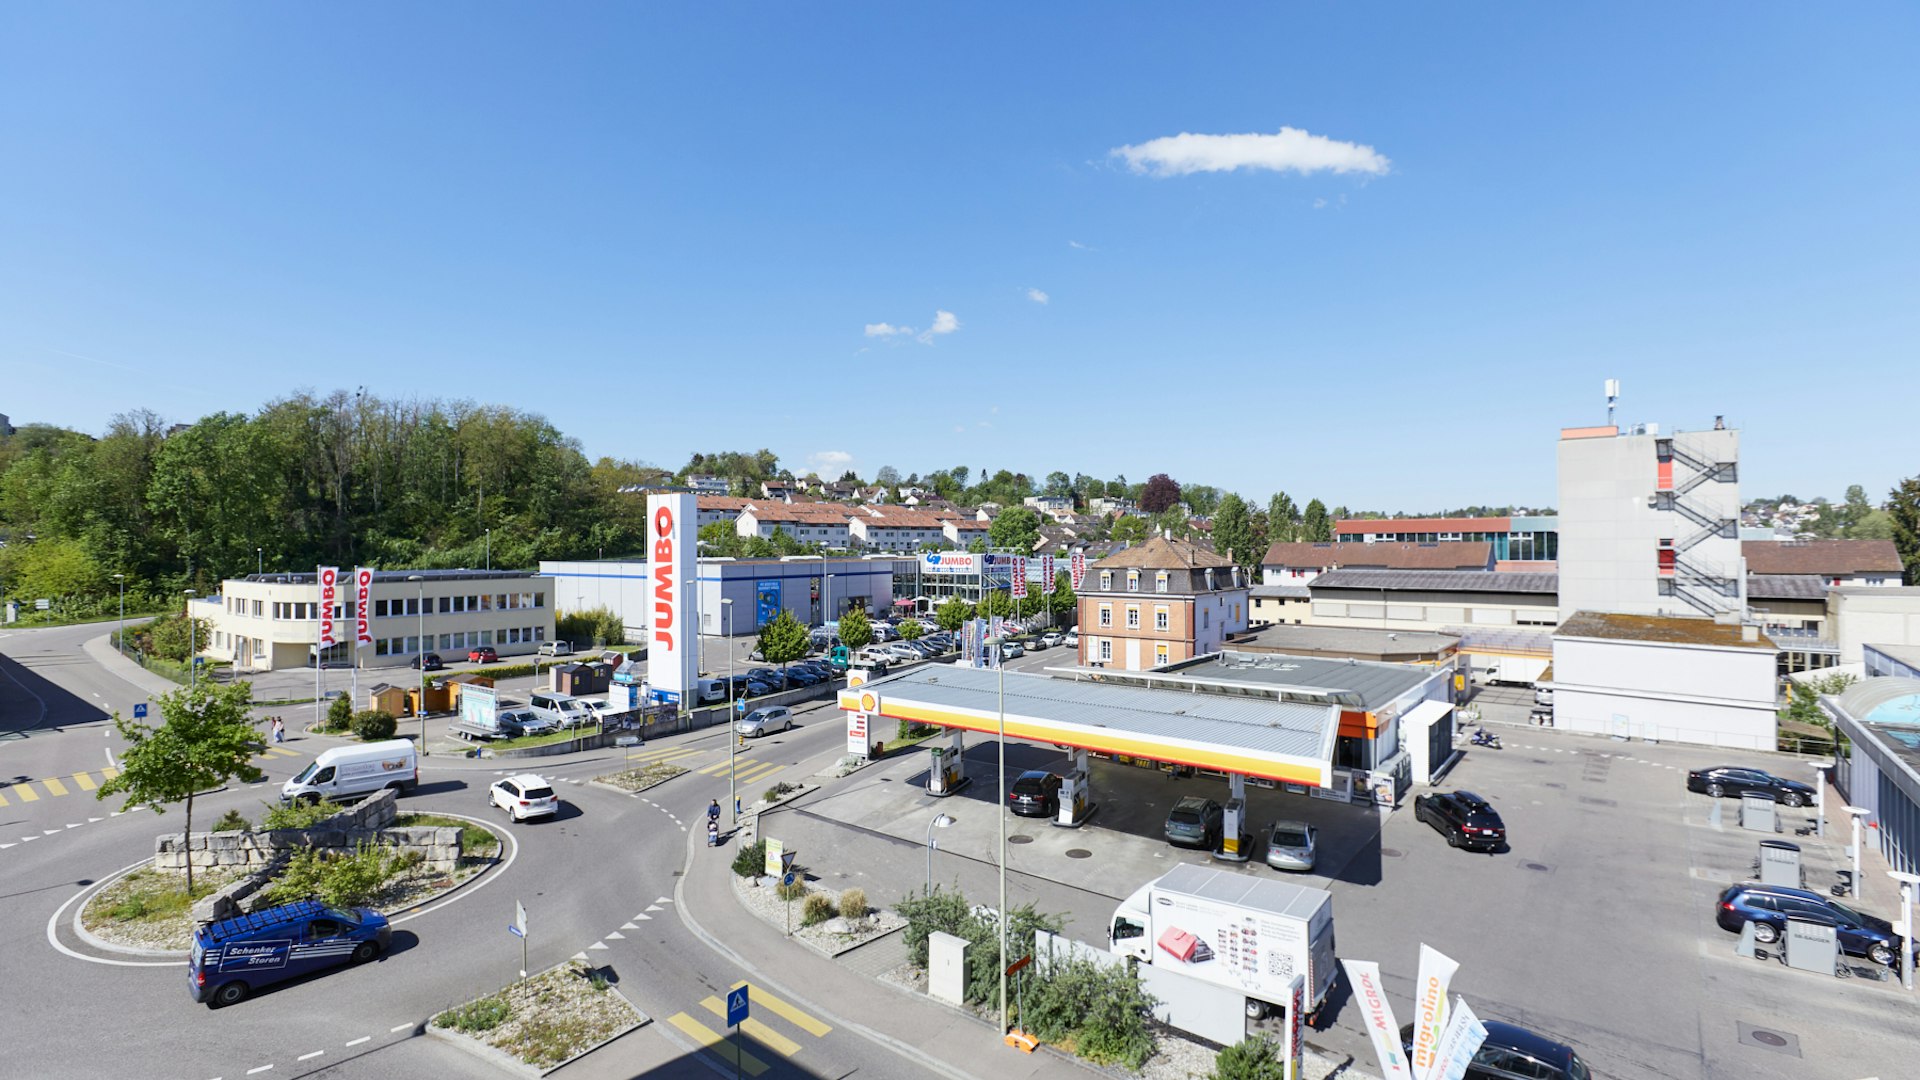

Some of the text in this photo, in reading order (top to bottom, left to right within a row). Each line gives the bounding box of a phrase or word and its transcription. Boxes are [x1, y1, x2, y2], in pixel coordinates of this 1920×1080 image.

[655, 506, 673, 651] JUMBO
[940, 557, 972, 566] JUMBO
[993, 556, 1011, 565] JUMB
[1012, 558, 1020, 596] JUMBO
[321, 570, 335, 646] JUMBO
[357, 571, 372, 644] JUMBO
[229, 945, 276, 956] Schenker
[247, 956, 281, 965] Storen
[1360, 972, 1387, 1031] MIGROL
[1414, 976, 1440, 1068] migrolino
